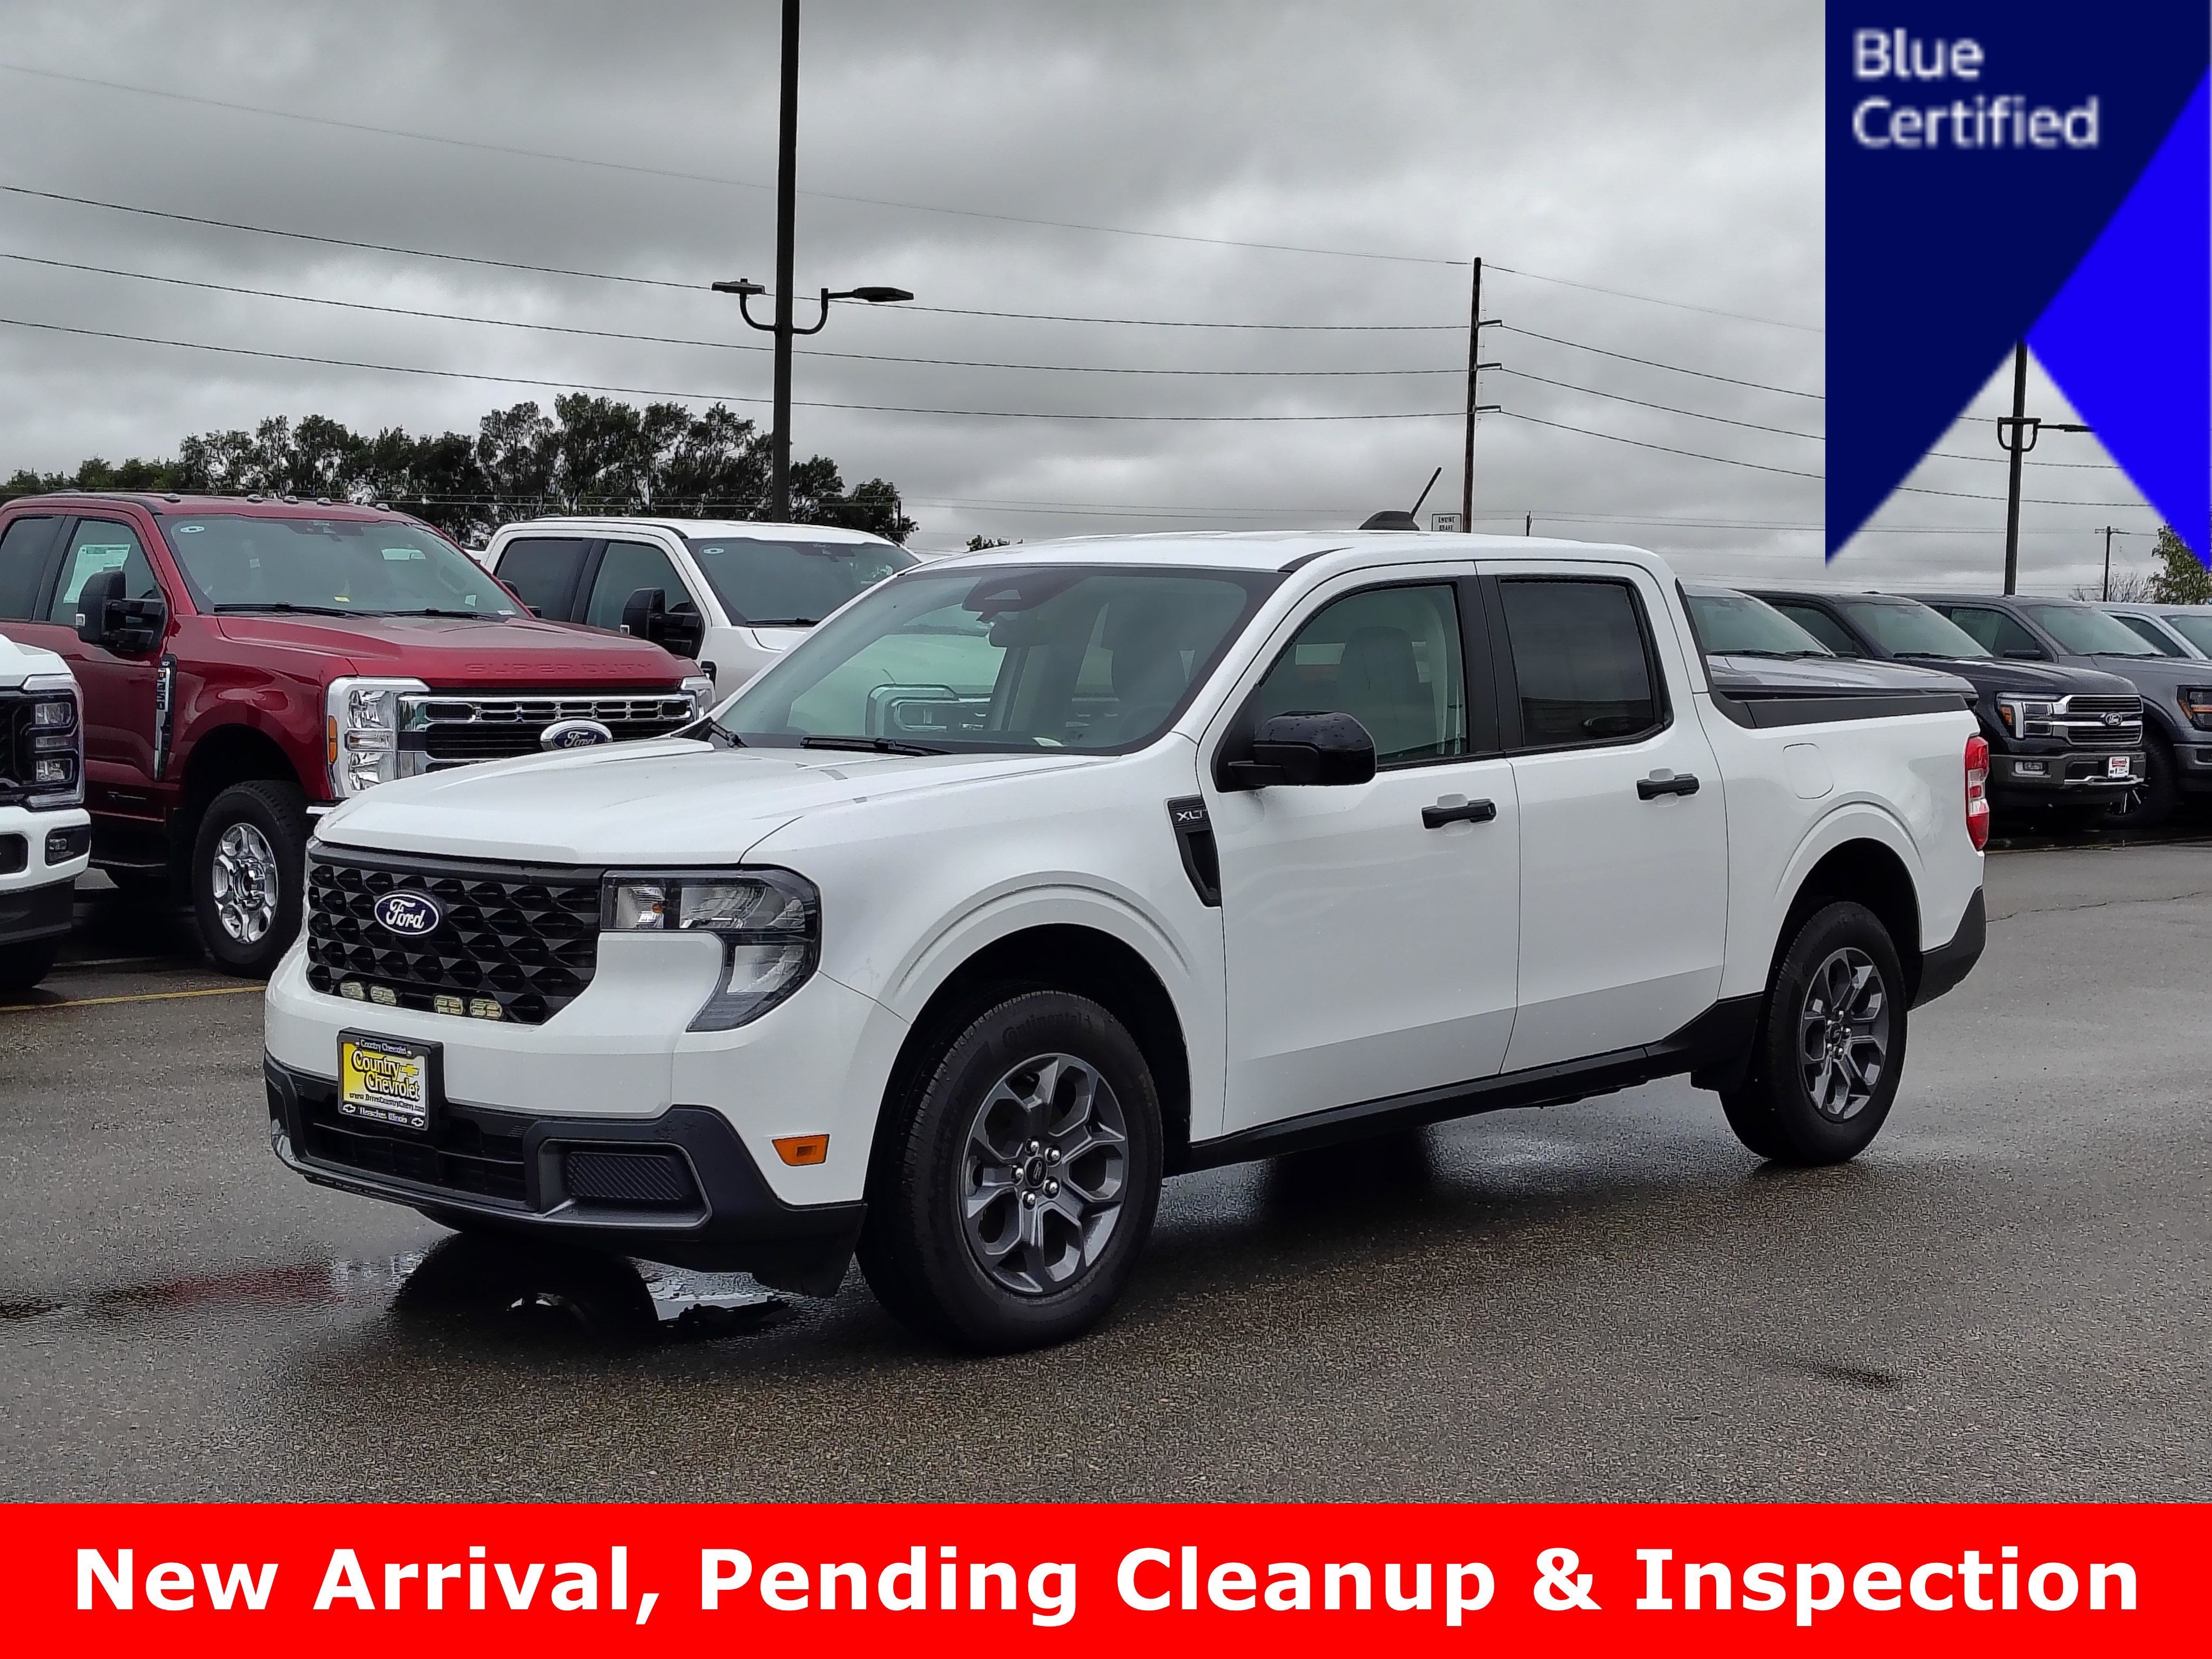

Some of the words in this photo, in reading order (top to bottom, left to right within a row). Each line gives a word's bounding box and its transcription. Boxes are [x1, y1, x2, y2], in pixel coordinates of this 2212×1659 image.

[465, 663, 576, 674] SUPER
[581, 663, 651, 674] DUTY
[564, 731, 597, 747] Ford
[1176, 808, 1206, 821] XLT
[386, 899, 426, 929] Ford
[352, 1050, 400, 1082] Country
[365, 1071, 420, 1101] Chevrolet
